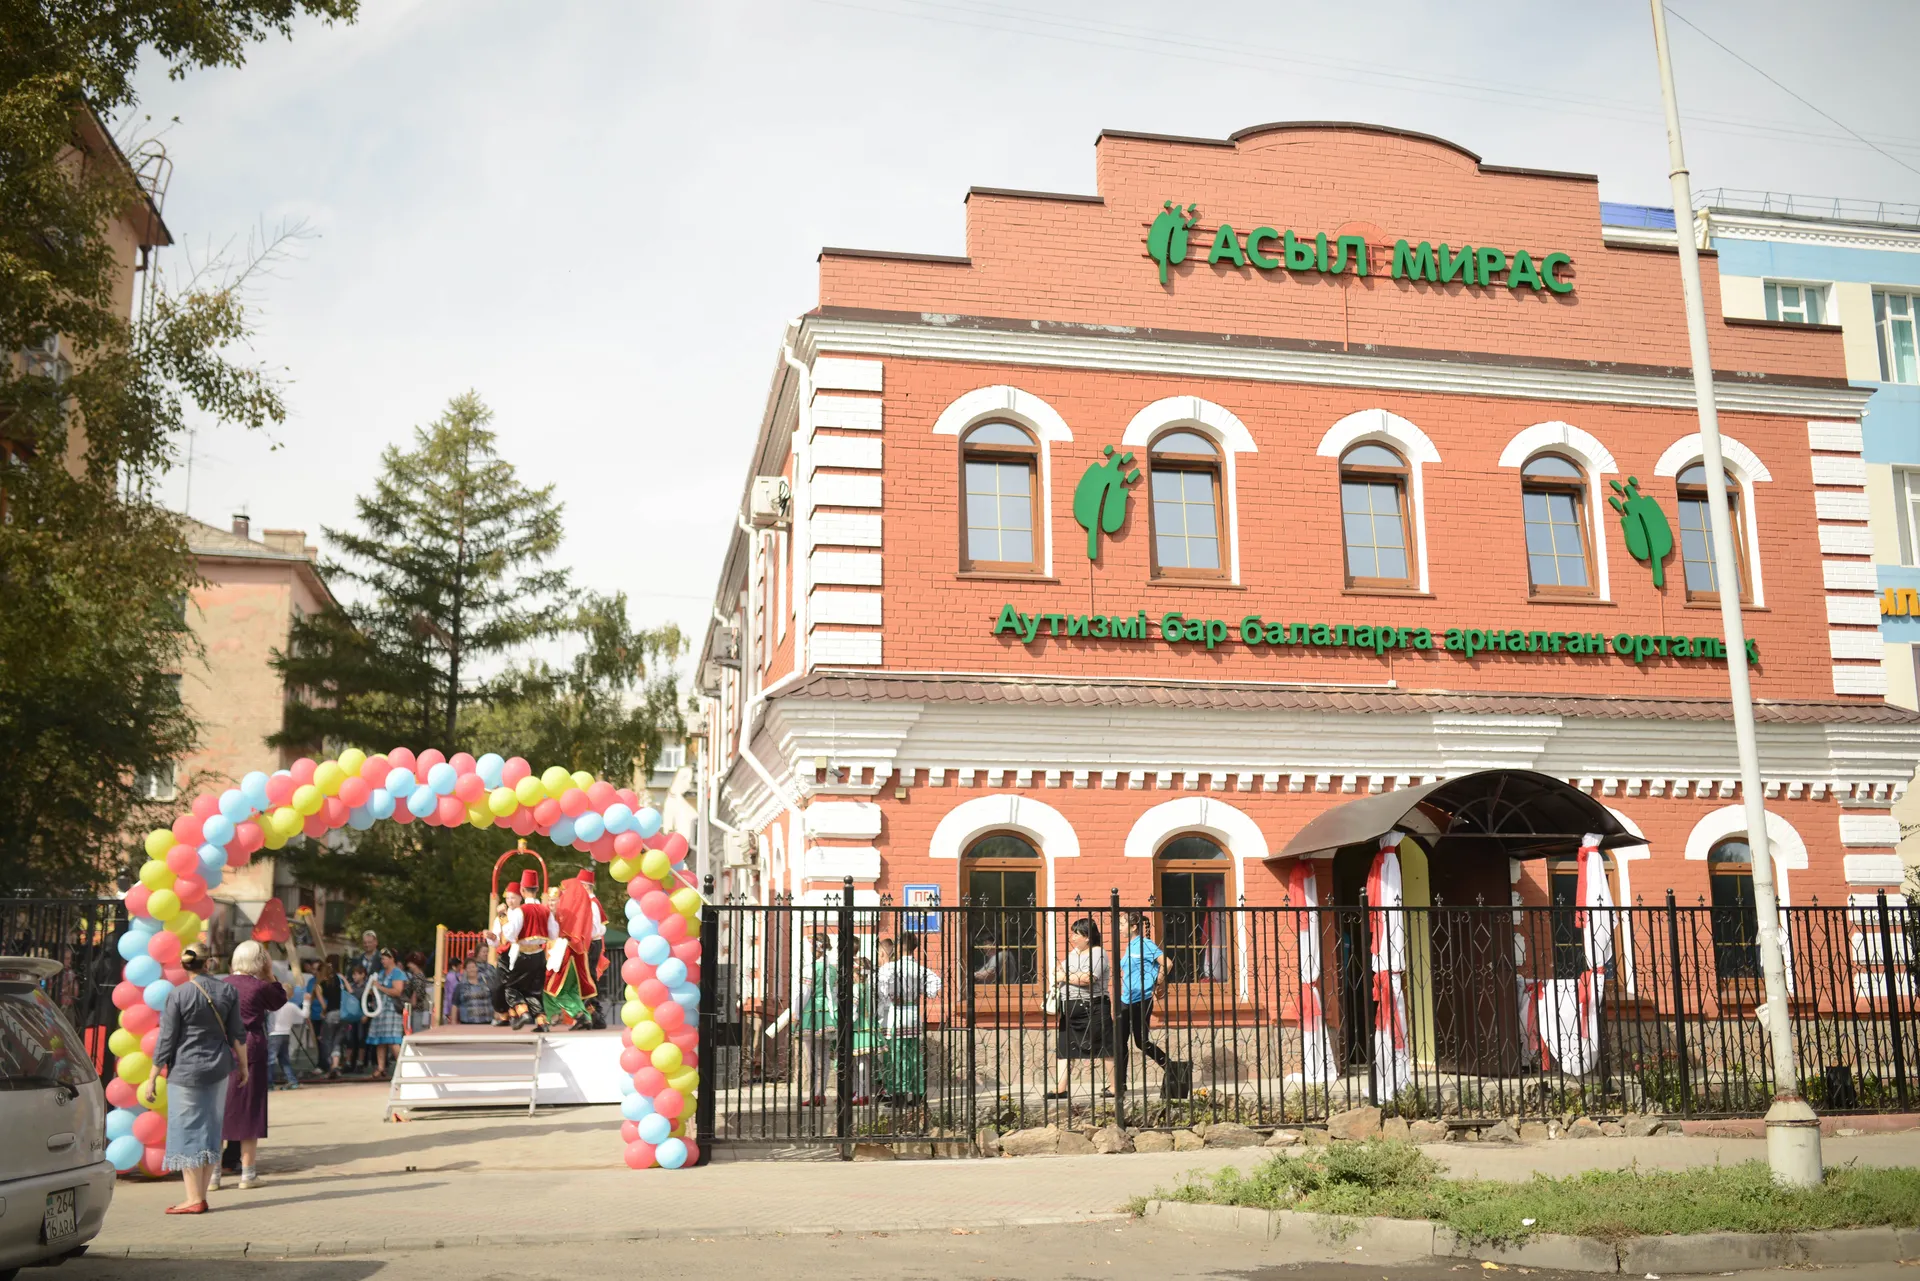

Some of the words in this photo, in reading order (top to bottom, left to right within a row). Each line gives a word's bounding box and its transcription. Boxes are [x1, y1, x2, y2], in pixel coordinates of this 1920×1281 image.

[1209, 224, 1367, 276] АСЫЛ
[1392, 239, 1573, 293] МИРАС
[995, 603, 1146, 643] Аутизмі
[1161, 612, 1228, 649] бар
[1239, 615, 1432, 655] балаларға
[1444, 628, 1605, 657] арналған
[46, 1219, 57, 1239] 16
